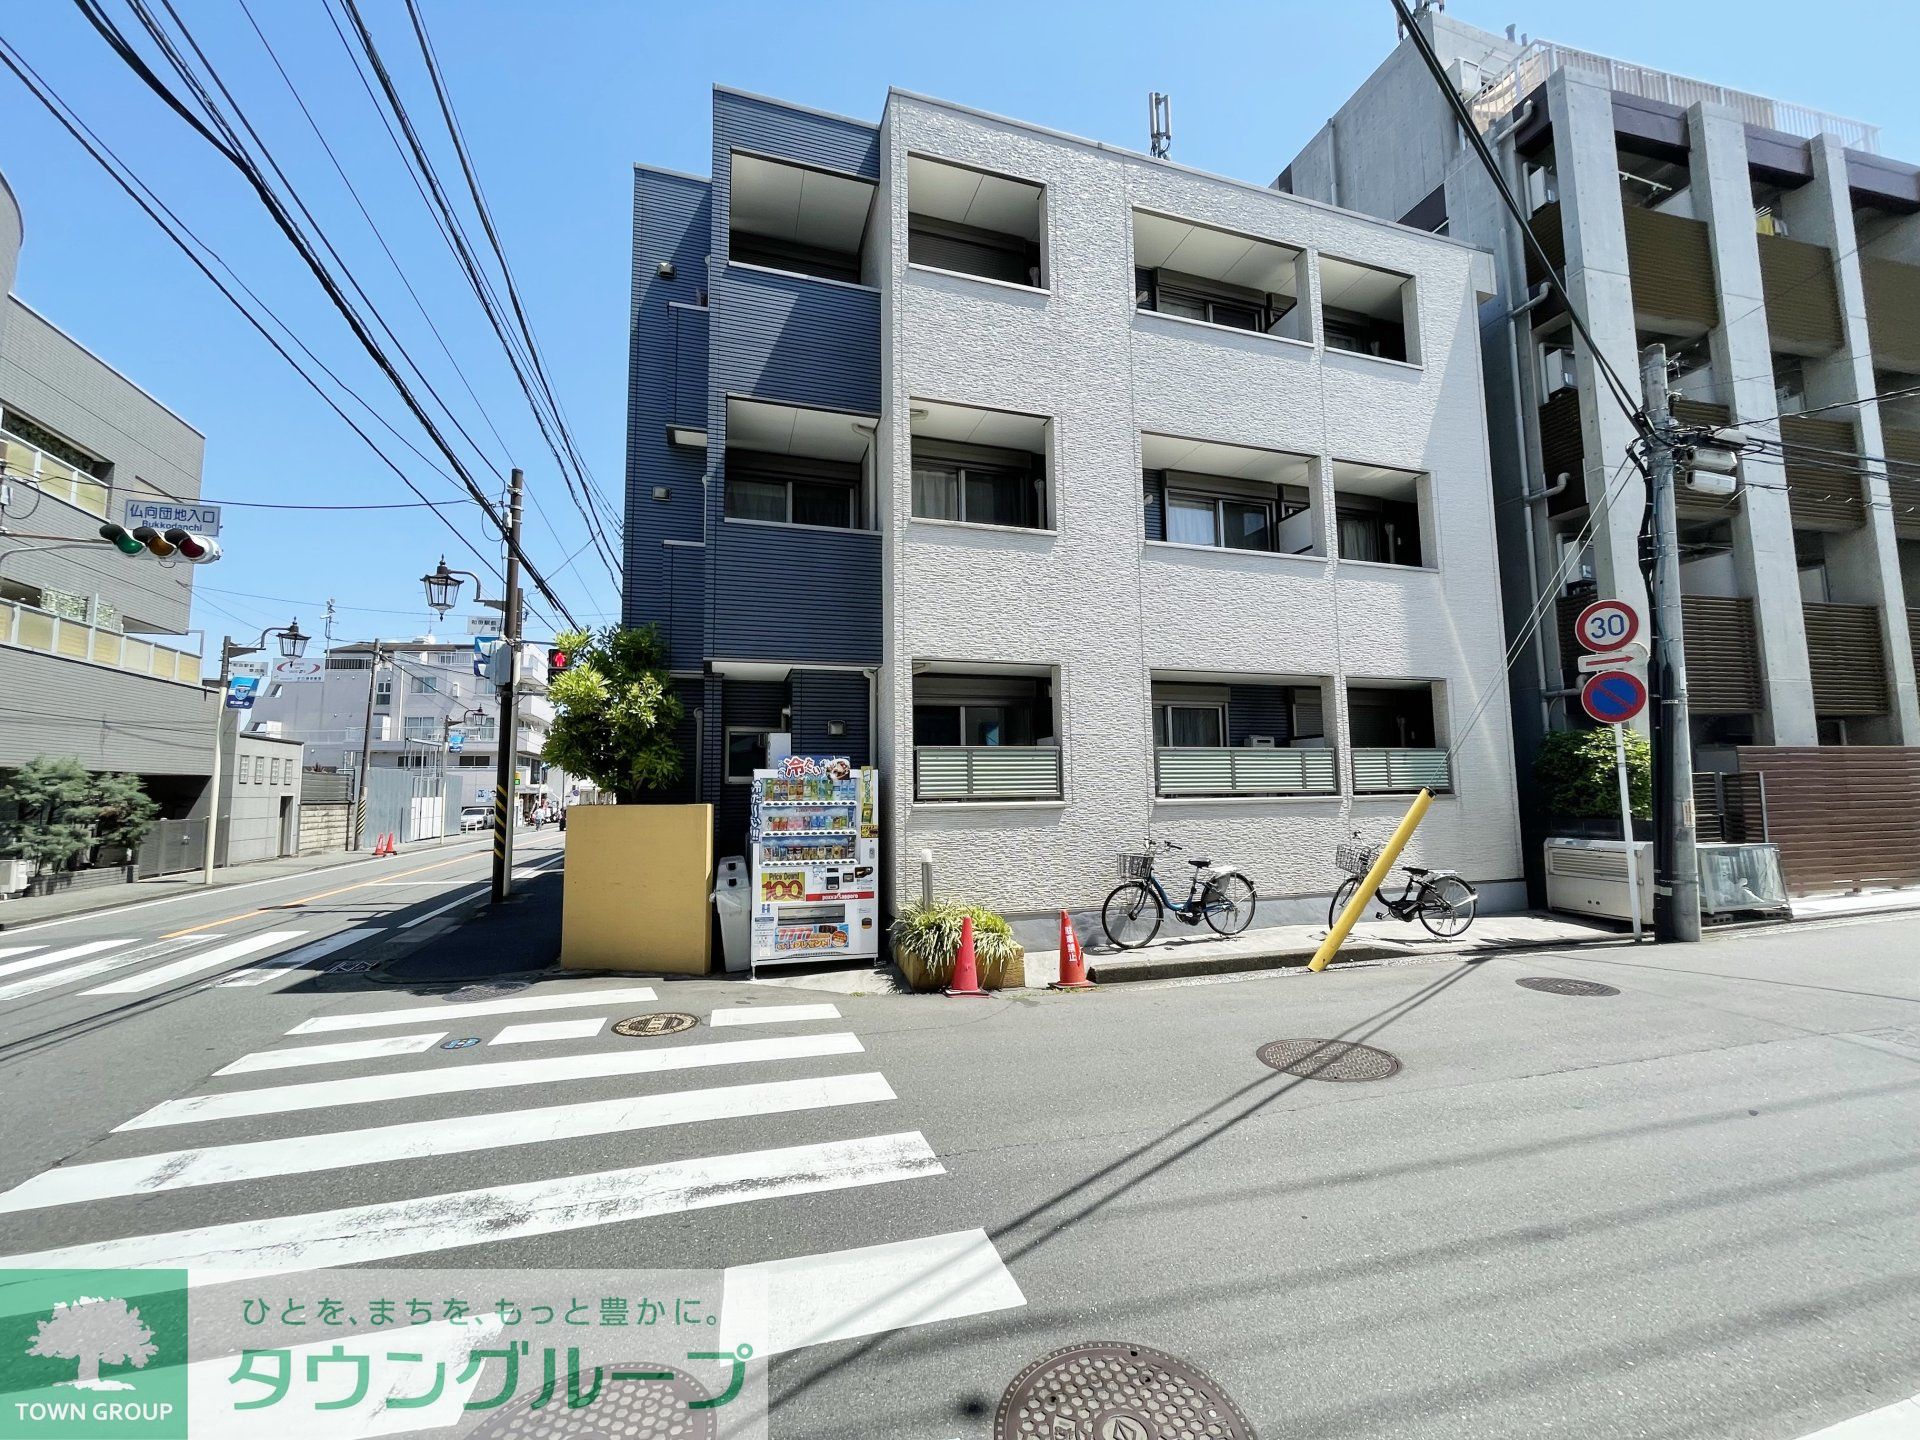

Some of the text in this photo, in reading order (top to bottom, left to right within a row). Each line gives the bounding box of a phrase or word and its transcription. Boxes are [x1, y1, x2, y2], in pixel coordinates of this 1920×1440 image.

[130, 504, 215, 523] 仏向団地入口
[142, 520, 203, 532] Bukkodanchi
[1590, 614, 1625, 639] 30
[762, 880, 804, 901] 100
